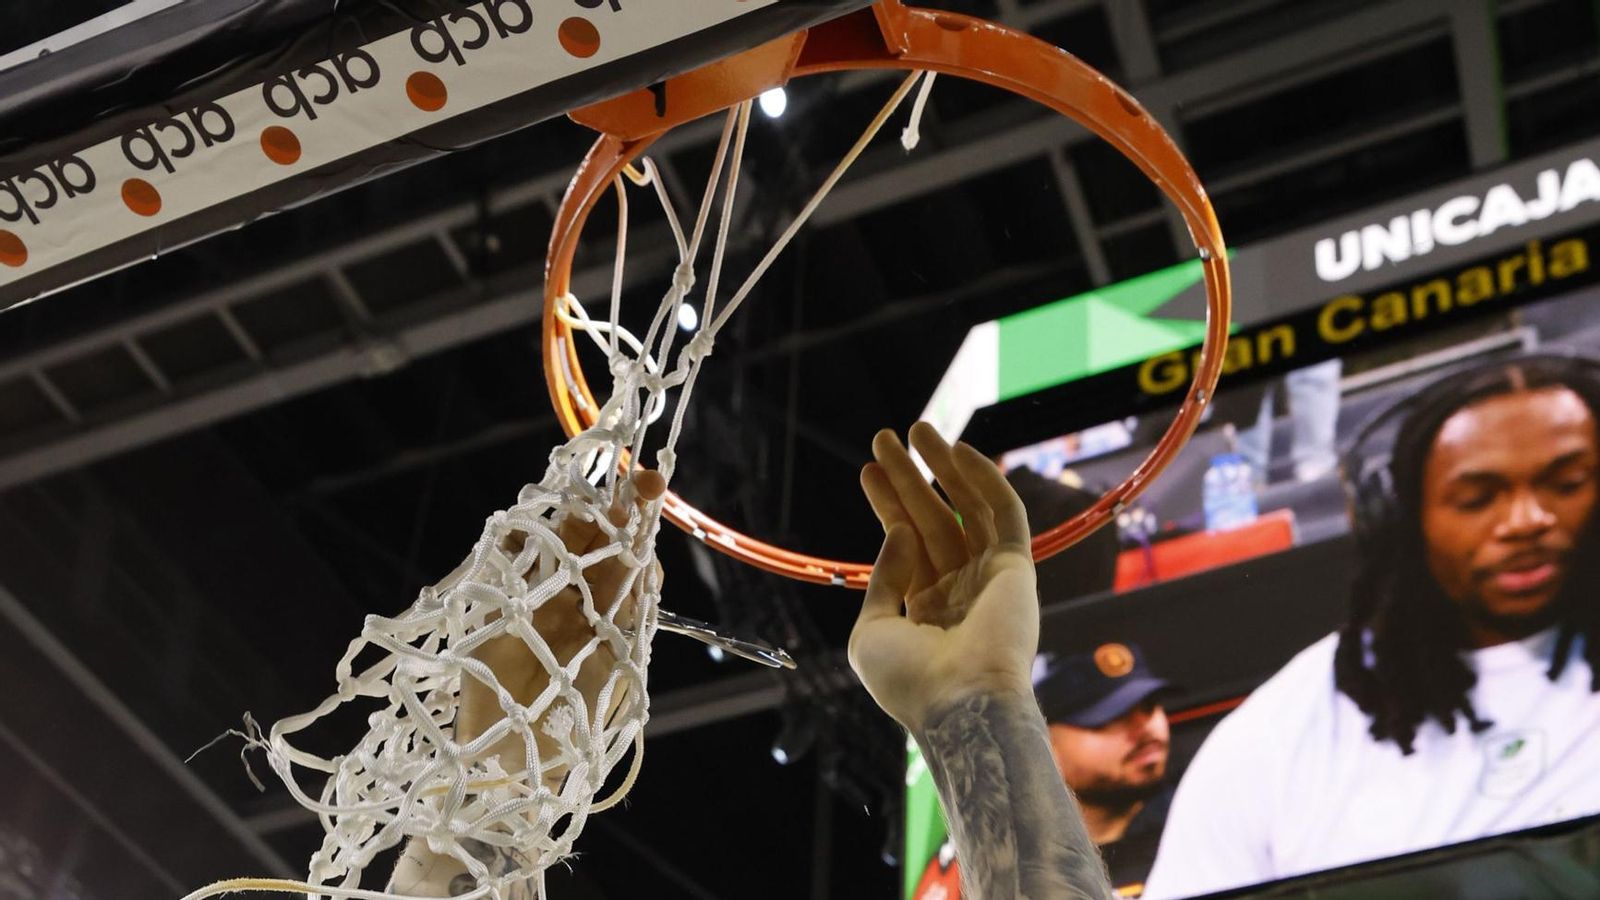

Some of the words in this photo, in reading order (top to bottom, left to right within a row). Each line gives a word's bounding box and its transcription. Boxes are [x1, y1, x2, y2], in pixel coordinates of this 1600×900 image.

[410, 0, 533, 66] acb
[263, 48, 380, 120] acb
[121, 101, 235, 174] acb
[1315, 158, 1600, 281] UNICAJA
[1317, 239, 1589, 344] Canaria
